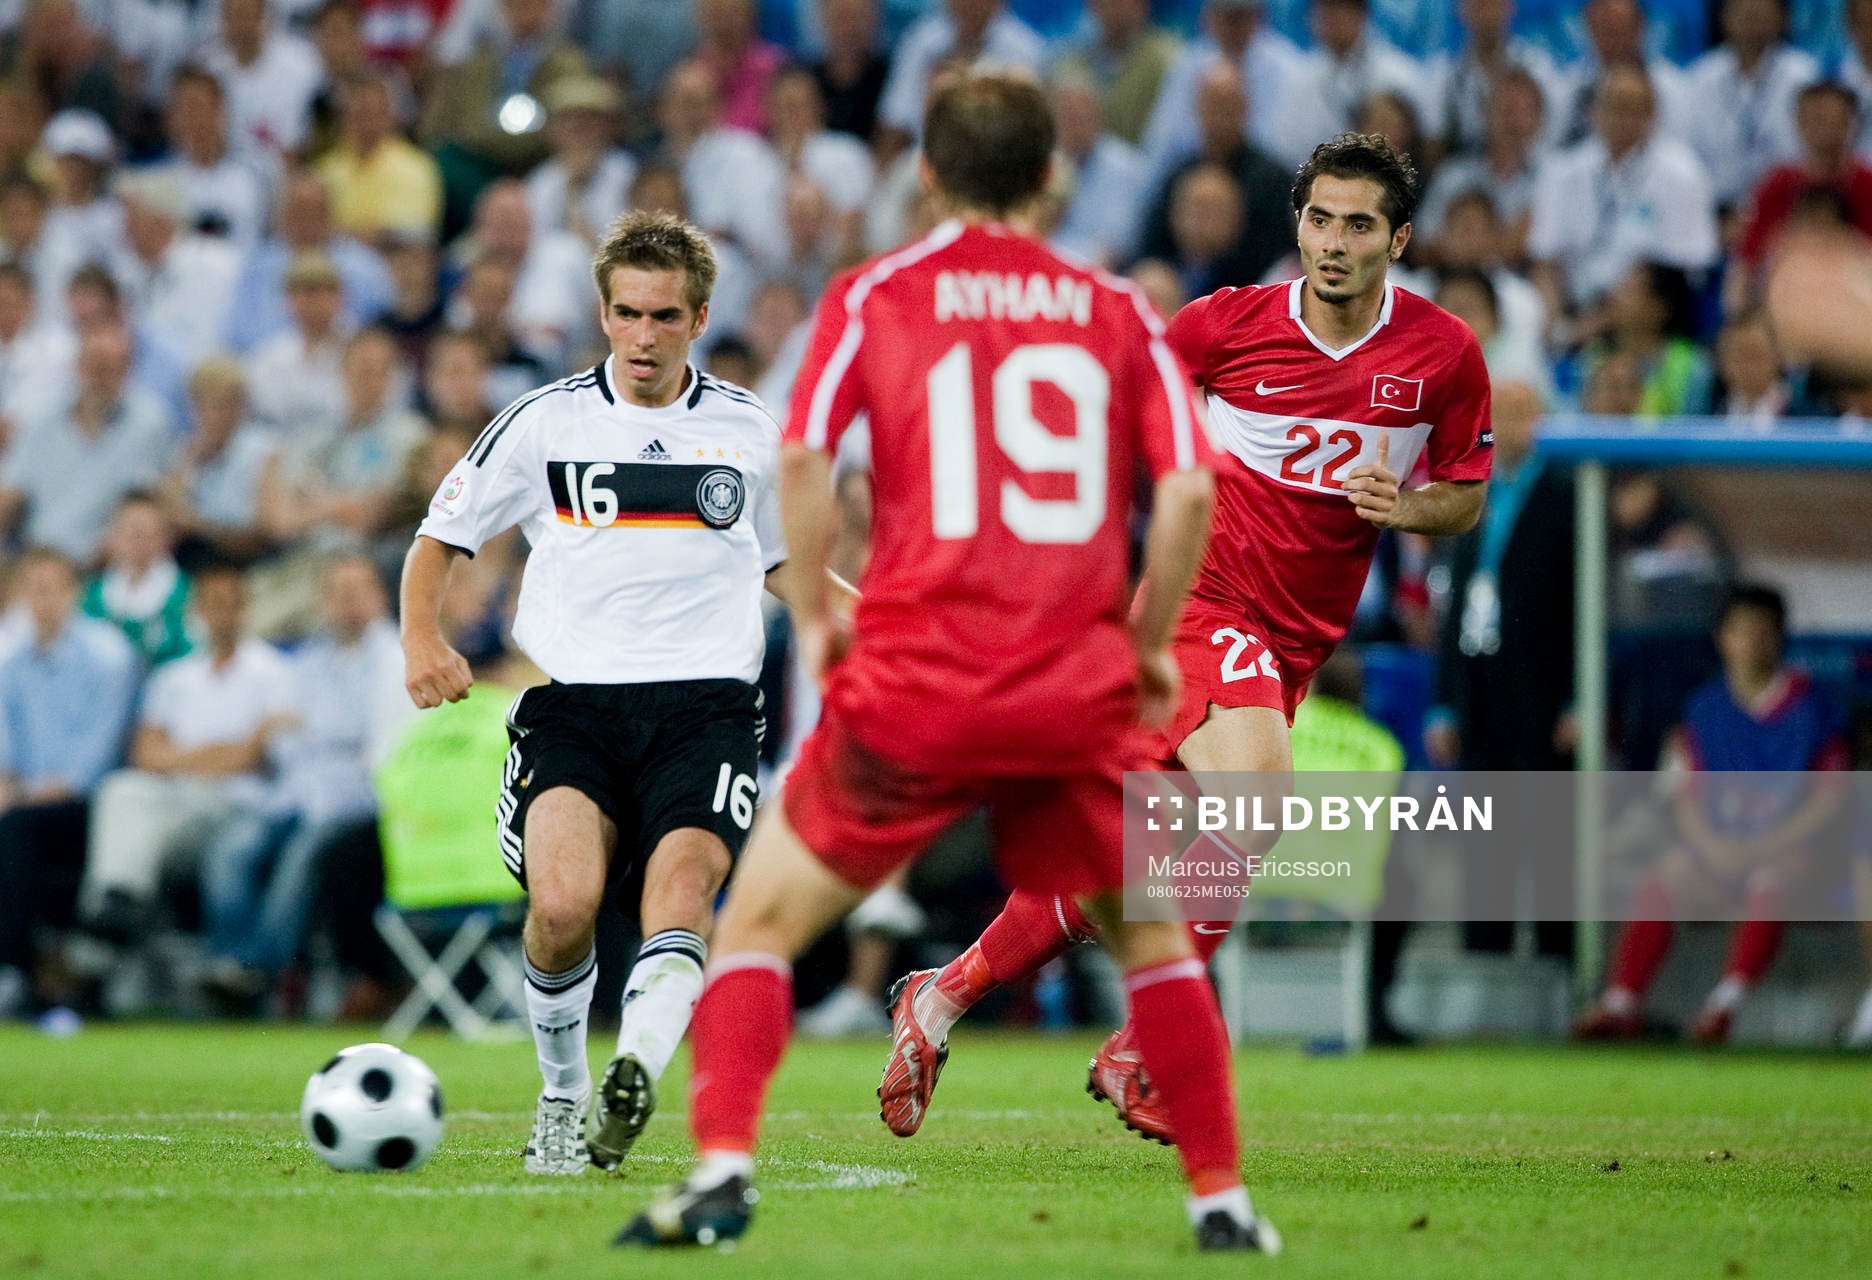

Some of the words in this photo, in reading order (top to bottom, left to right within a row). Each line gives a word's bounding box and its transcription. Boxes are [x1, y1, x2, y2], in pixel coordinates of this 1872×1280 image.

[934, 270, 1093, 327] AYHAN
[637, 452, 672, 461] adidas
[927, 340, 1111, 544] 19
[1280, 424, 1363, 490] 22
[565, 462, 619, 528] 16
[712, 762, 758, 830] 16
